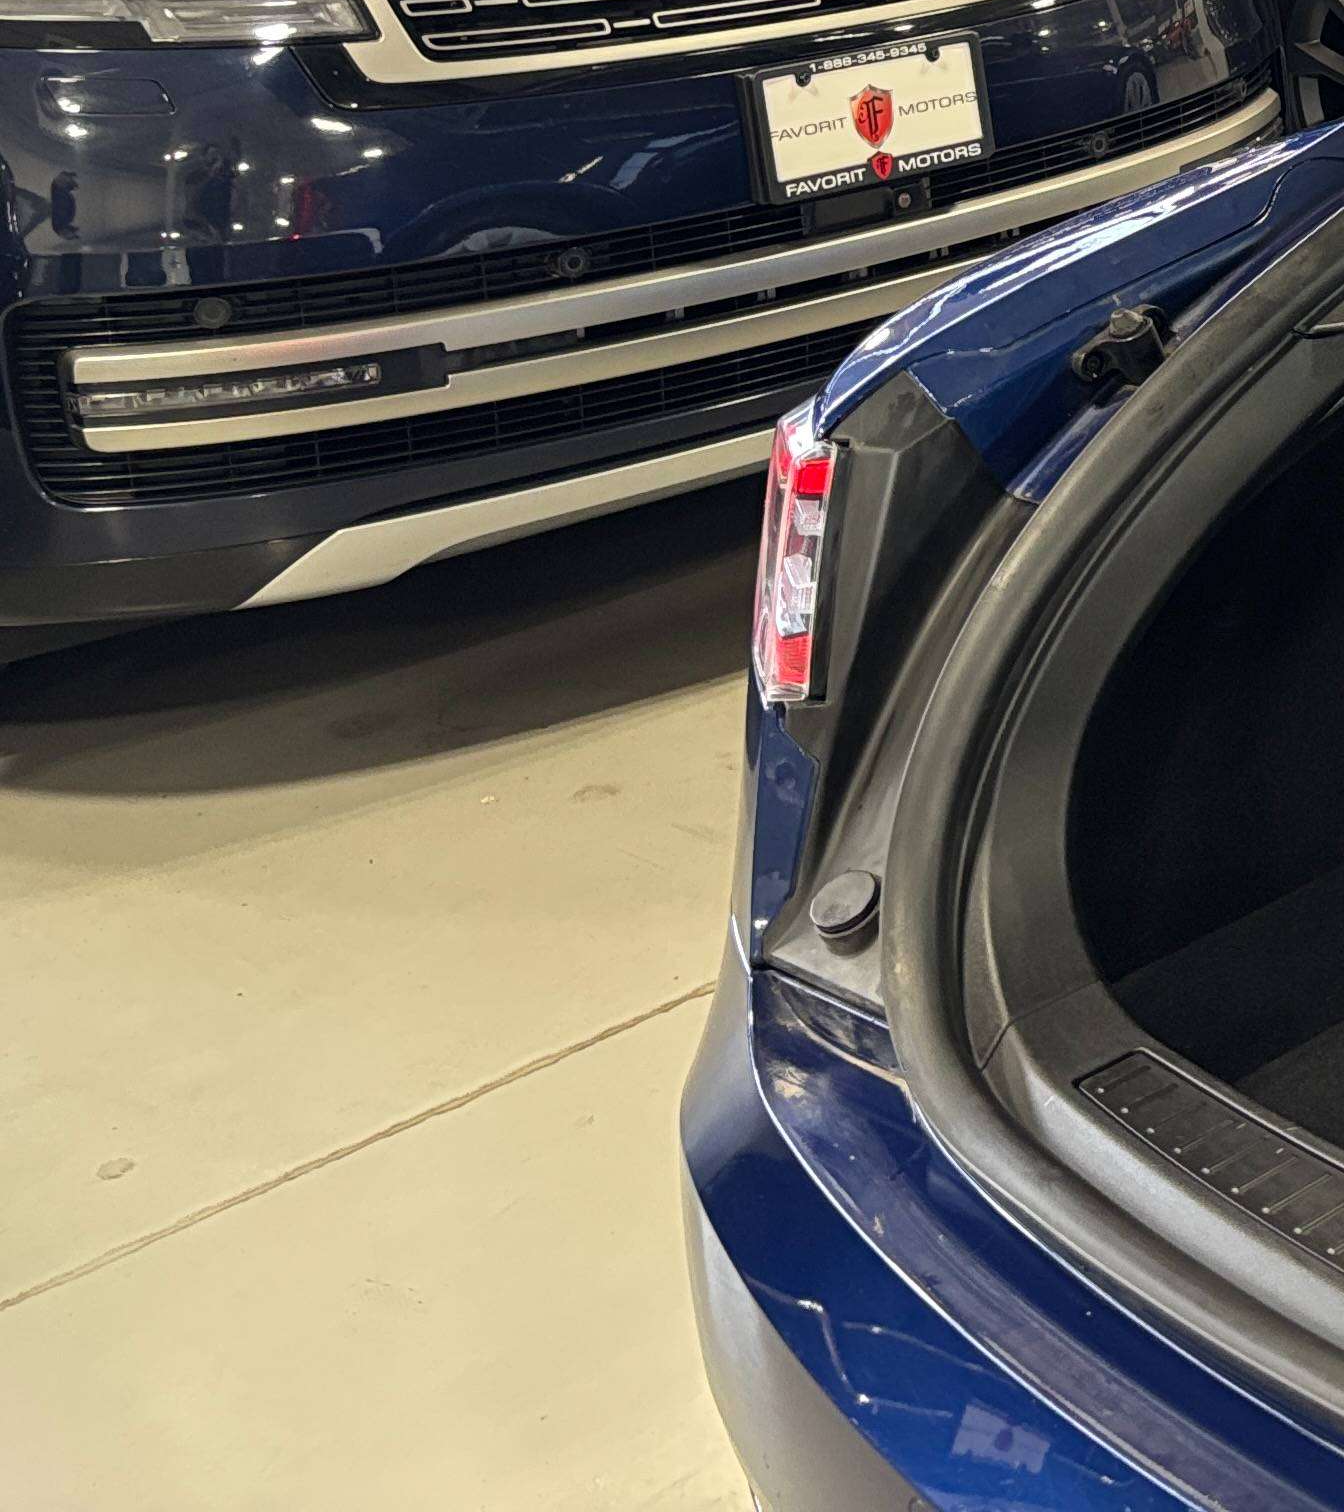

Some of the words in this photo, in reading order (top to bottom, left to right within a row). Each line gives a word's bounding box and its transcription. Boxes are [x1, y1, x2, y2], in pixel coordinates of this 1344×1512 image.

[808, 42, 927, 73] 1-888-345-9345
[768, 116, 848, 141] FAVORIT
[898, 91, 978, 117] MOTORS
[785, 168, 867, 198] FAVORIT
[897, 143, 982, 172] MOTORS
